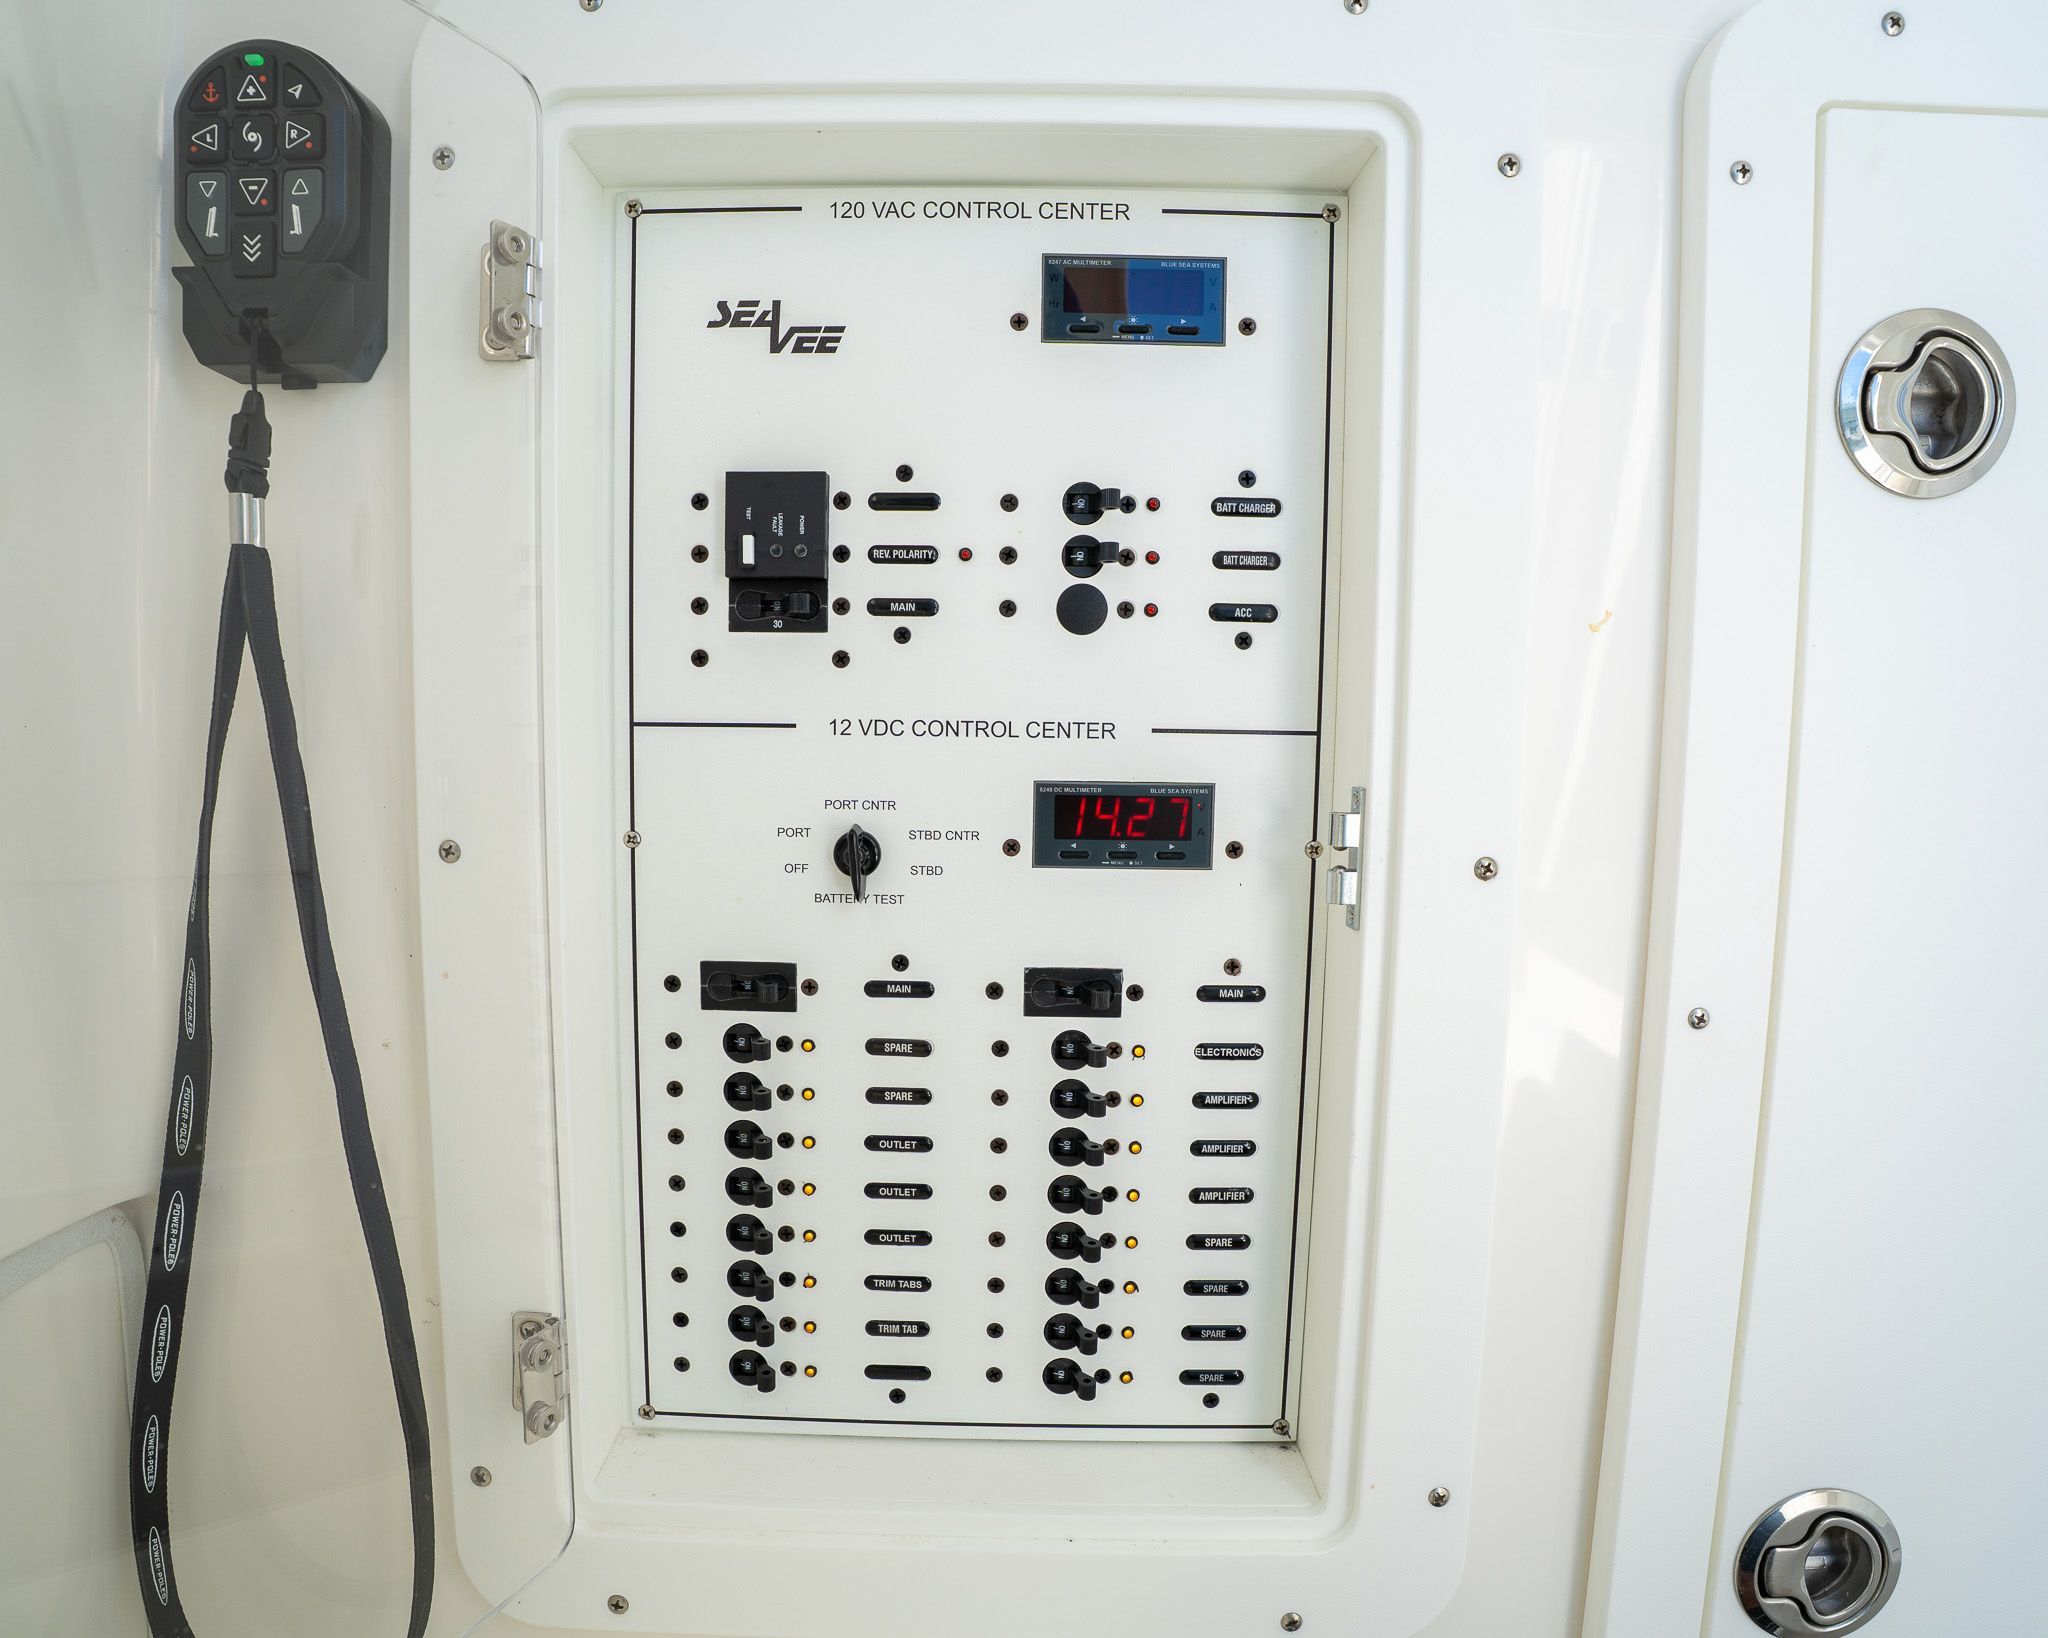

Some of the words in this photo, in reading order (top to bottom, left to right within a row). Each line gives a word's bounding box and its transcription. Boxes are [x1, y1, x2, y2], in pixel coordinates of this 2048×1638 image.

[206, 133, 213, 143] L
[291, 128, 298, 139] R
[830, 202, 865, 219] 120
[872, 201, 916, 219] VAC
[923, 201, 1032, 219] CONTROL
[1039, 202, 1130, 220] CENTER
[1216, 503, 1237, 513] BATT
[1238, 503, 1276, 514] CHARGER
[873, 550, 891, 559] REV.
[892, 550, 933, 559] POLARITY
[1223, 555, 1239, 565] BATT
[1239, 555, 1268, 566] CHARGER
[890, 602, 916, 612] MAIN
[1234, 608, 1252, 618] ACC
[773, 620, 783, 629] 30
[829, 719, 852, 736] 12
[858, 719, 905, 737] VDC
[911, 720, 1020, 738] CONTROL
[1026, 721, 1117, 740] CENTER
[824, 800, 859, 810] PORT
[861, 800, 897, 811] CNTR
[1075, 797, 1190, 838] 14.27
[777, 827, 812, 838] PORT
[908, 829, 942, 841] STBD
[945, 830, 980, 841] CNTR
[784, 863, 809, 874] OFF
[910, 865, 944, 876] STBD
[873, 894, 905, 905] TEST
[887, 984, 912, 993] MAIN
[1219, 988, 1244, 998] MAIN
[884, 1043, 913, 1053] SPARE
[1195, 1047, 1262, 1057] ELECTRONICS
[884, 1091, 913, 1101] SPARE
[1204, 1095, 1247, 1105] AMPLIFIER
[879, 1140, 917, 1150] OUTLET
[1201, 1144, 1244, 1154] AMPLIFIER
[879, 1187, 917, 1197] OUTLET
[1199, 1191, 1245, 1201] AMPLIFIER
[879, 1234, 917, 1243] OUTLET
[1204, 1238, 1233, 1247] SPARE
[873, 1279, 896, 1288] TRIM
[898, 1280, 923, 1289] TABS
[1203, 1284, 1229, 1293] SPARE
[878, 1324, 900, 1334] TRIM
[901, 1324, 918, 1334] TAB
[1201, 1329, 1226, 1338] SPARE
[1199, 1373, 1224, 1382] SPARE
